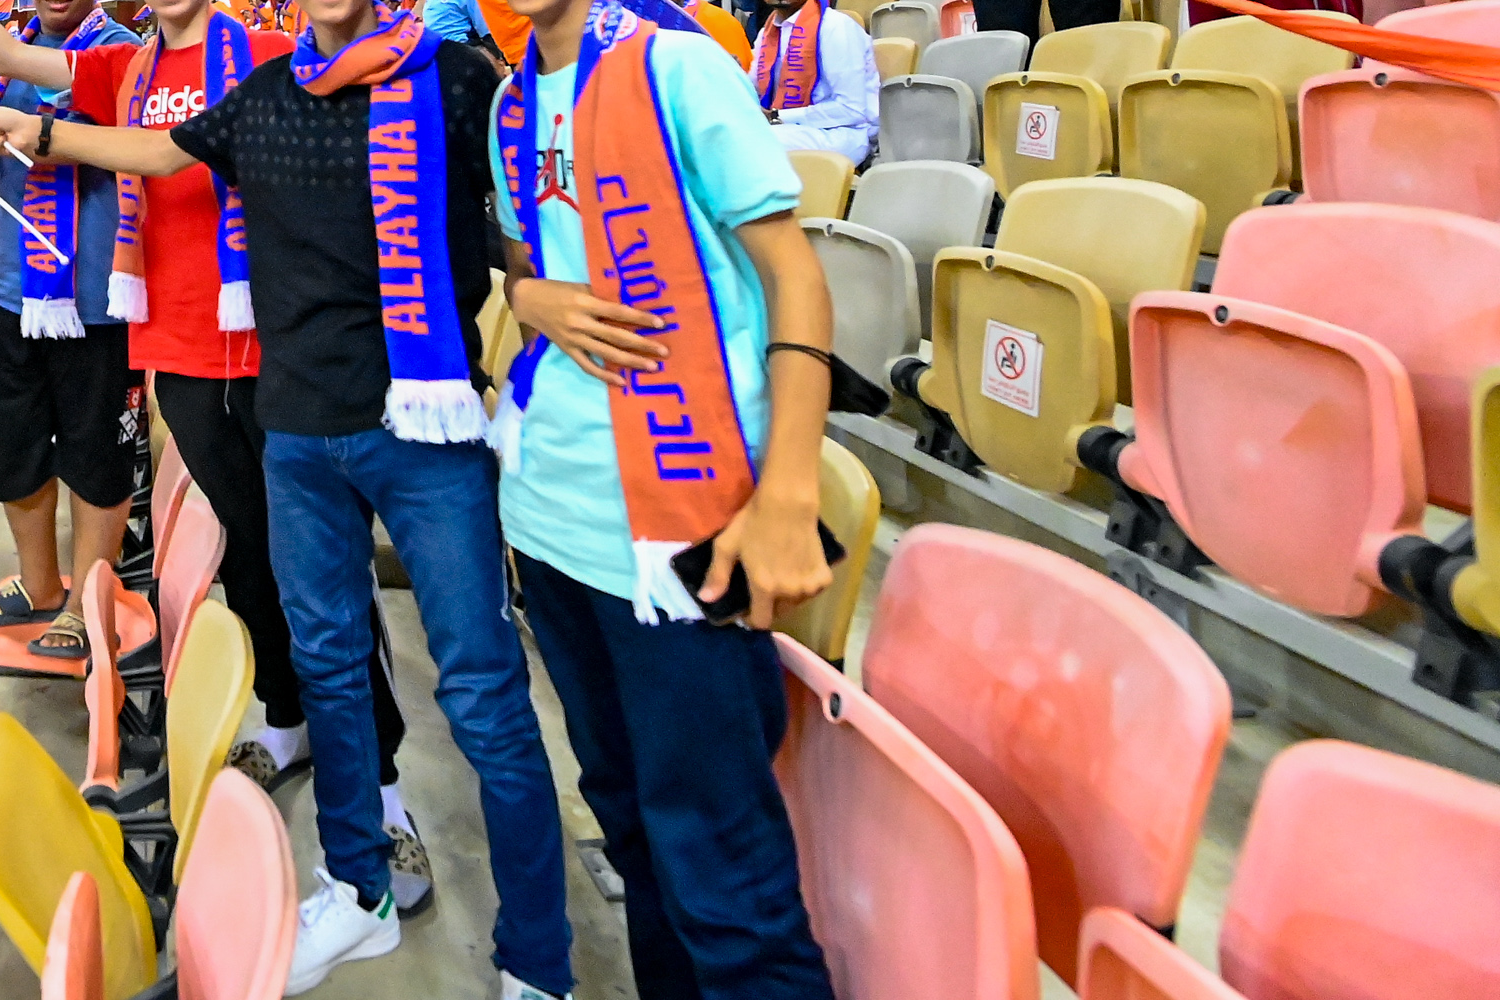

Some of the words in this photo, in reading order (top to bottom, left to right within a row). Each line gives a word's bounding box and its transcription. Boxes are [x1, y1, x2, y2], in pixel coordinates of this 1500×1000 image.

[23, 165, 57, 274] ALFAYH
[368, 119, 430, 335] ALFAYHA
[621, 360, 716, 481] نادي
